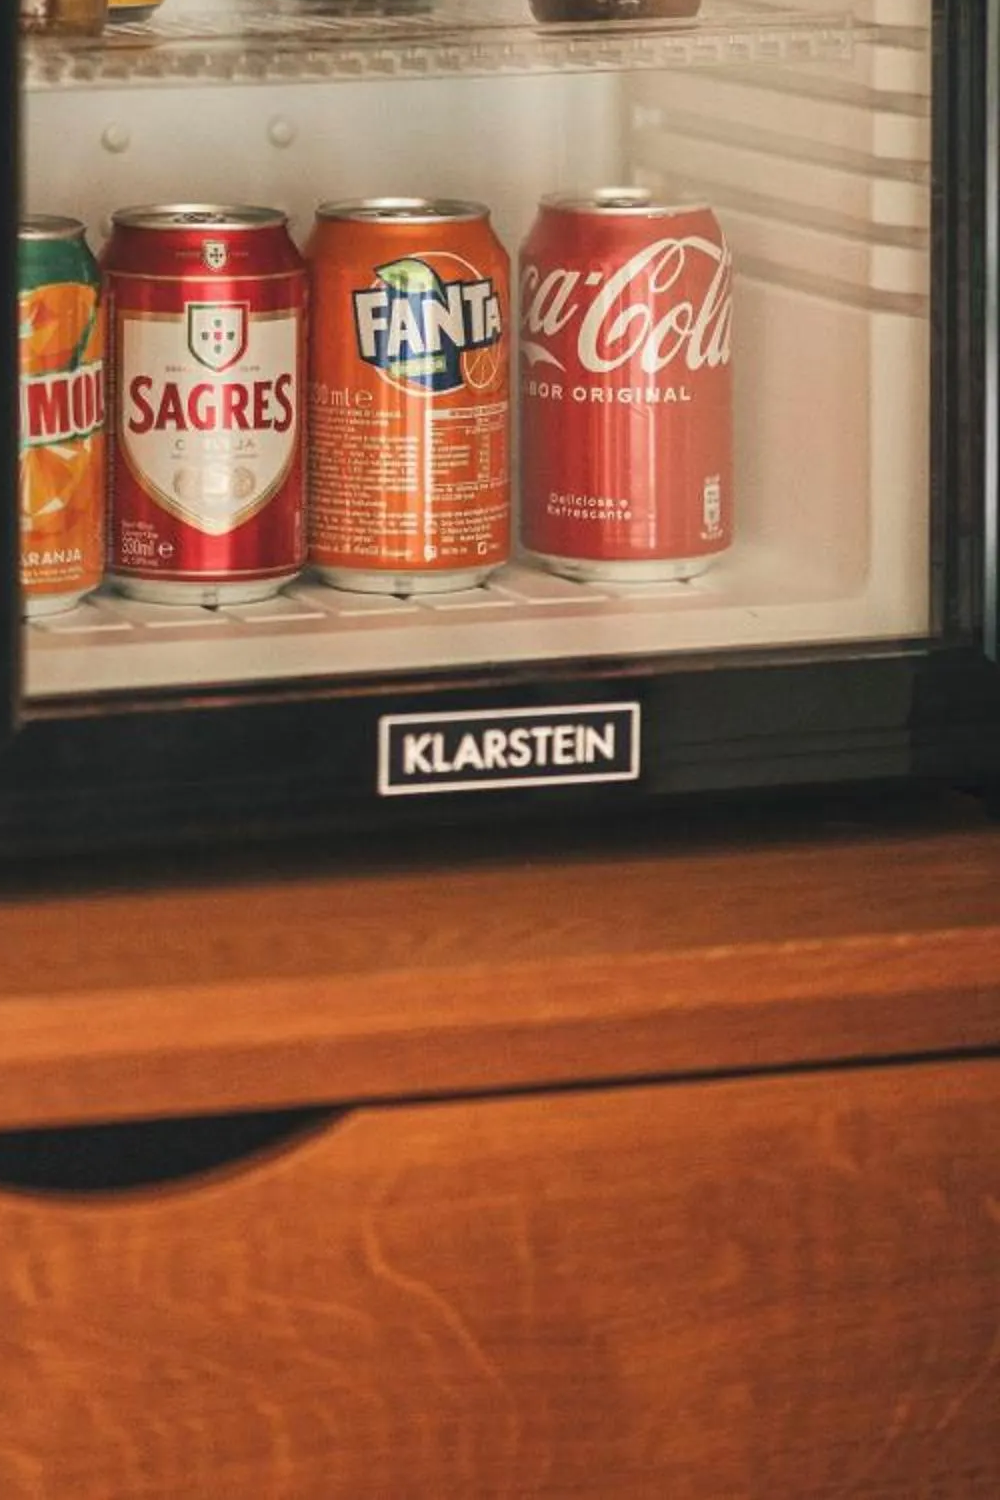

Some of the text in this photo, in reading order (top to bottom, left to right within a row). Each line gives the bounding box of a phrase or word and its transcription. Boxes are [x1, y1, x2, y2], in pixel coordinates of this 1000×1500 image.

[355, 281, 501, 358] FANTA
[27, 369, 105, 437] MOL
[128, 372, 294, 435] SAGRES
[528, 380, 692, 404] BOR ORIGINAL
[403, 722, 616, 775] KLARSTEIN
